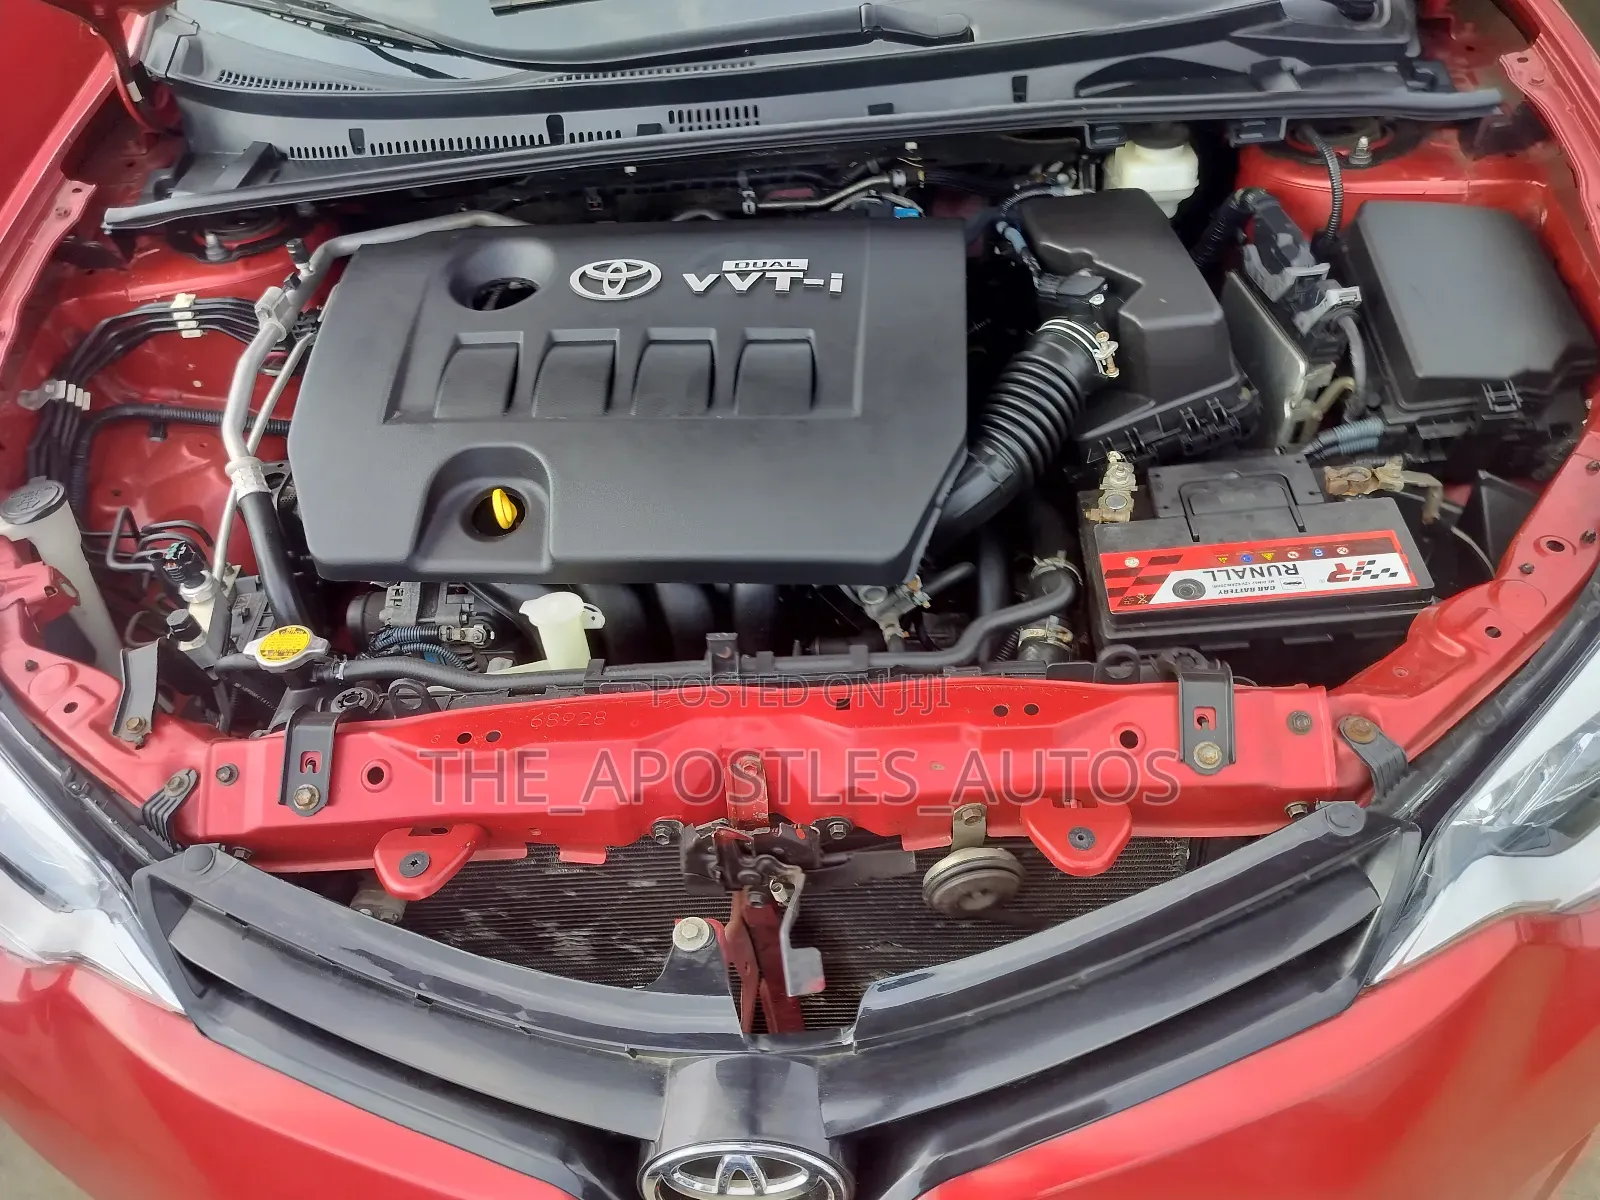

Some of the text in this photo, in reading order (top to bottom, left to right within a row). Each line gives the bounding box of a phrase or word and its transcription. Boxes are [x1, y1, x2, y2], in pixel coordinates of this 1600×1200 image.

[734, 260, 800, 269] DUAL
[682, 271, 844, 295] VVT-i
[1203, 563, 1300, 582] RUNALL
[1218, 587, 1256, 595] BATTERY
[529, 710, 608, 729] 68928
